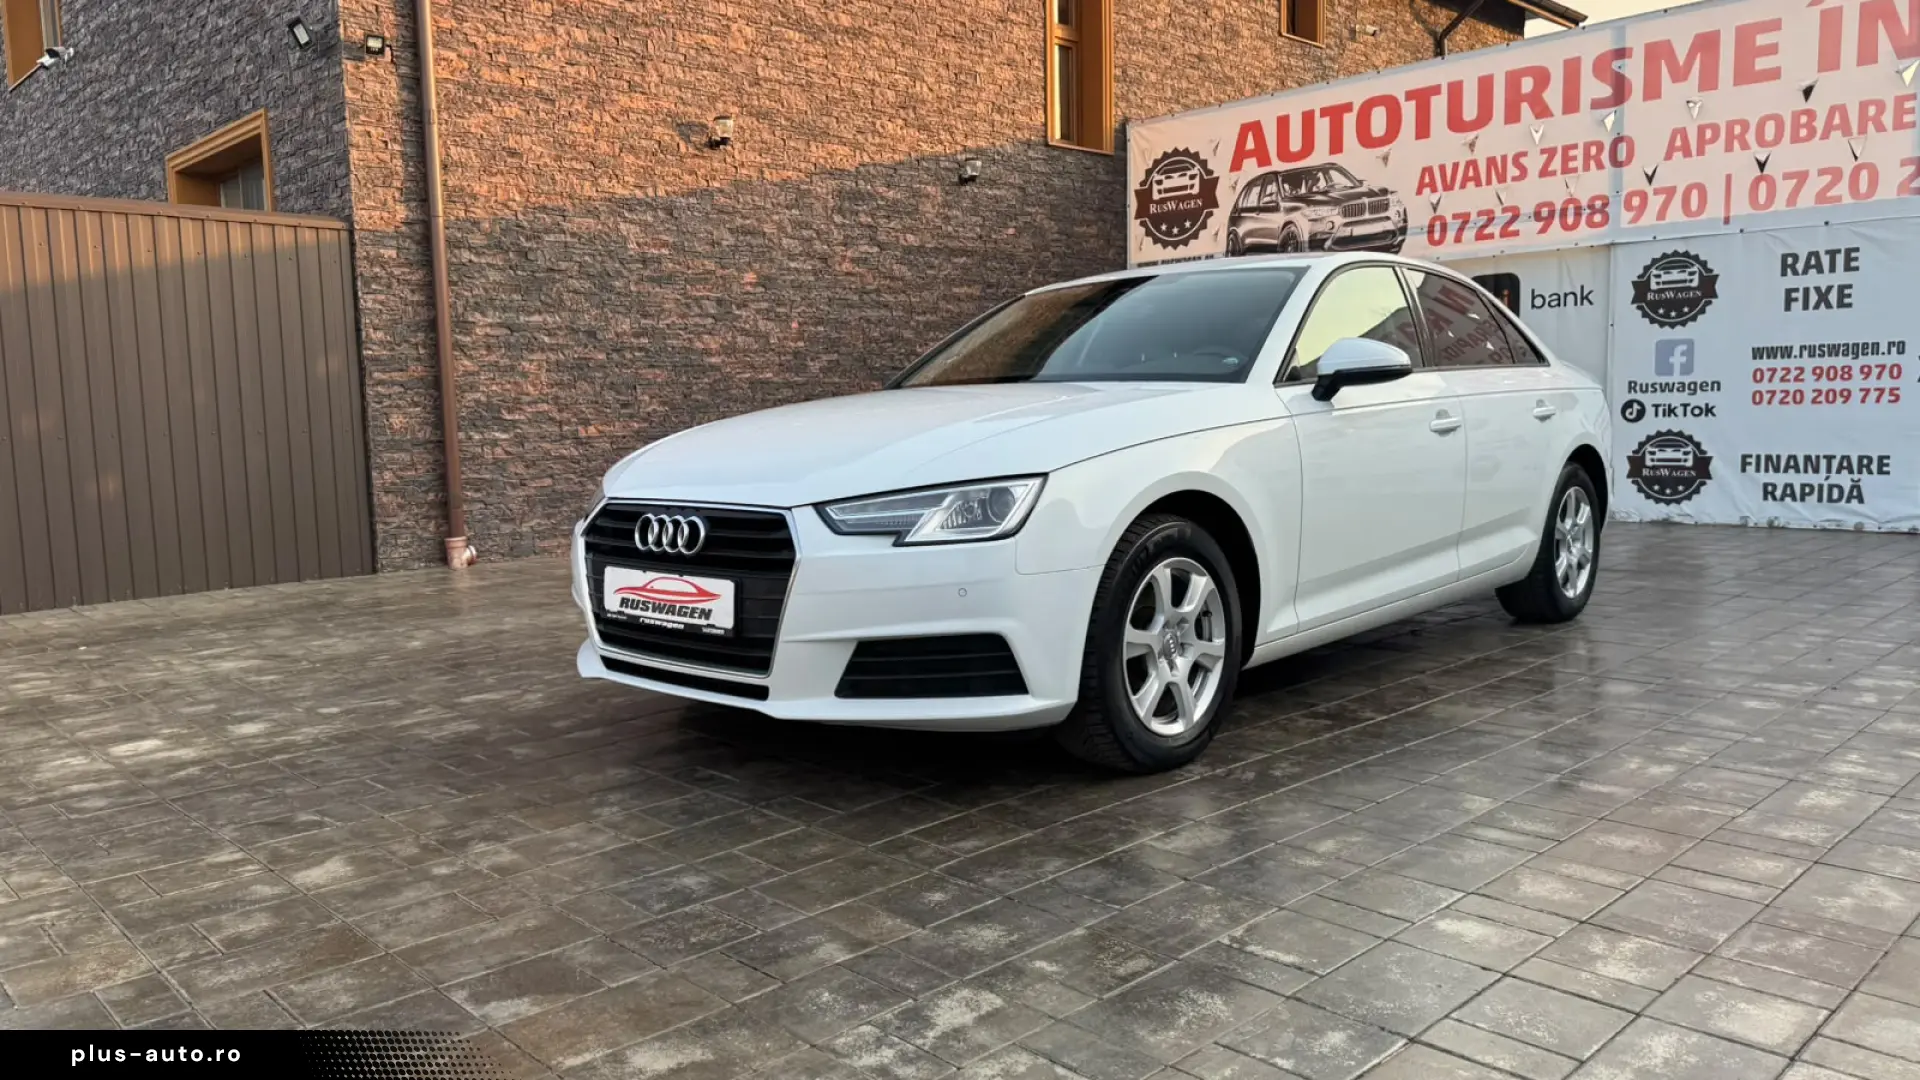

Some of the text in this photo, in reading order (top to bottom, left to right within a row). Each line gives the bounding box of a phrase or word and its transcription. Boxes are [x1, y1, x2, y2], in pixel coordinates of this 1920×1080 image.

[1229, 17, 1783, 173] AUTOTURISME
[1415, 92, 1918, 196] AVANS ZERO APROBARE
[1427, 205, 1521, 247] 0722
[1533, 194, 1610, 235] 908
[1624, 181, 1708, 225] 970
[1748, 161, 1880, 212] 0720
[1780, 247, 1861, 278] RATE
[1530, 284, 1595, 310] bank
[1783, 283, 1854, 312] FIXE
[1751, 340, 1906, 360] www.ruswagen.ro
[1752, 366, 1805, 384] 0722
[1811, 364, 1853, 382] 908
[1859, 363, 1902, 381] 970
[1627, 379, 1722, 396] Ruswagen
[1751, 386, 1901, 406] 0720 209 775
[1651, 402, 1717, 418] TikTok
[1762, 477, 1865, 504] RAPIDĂ
[618, 596, 713, 621] RUSWAGEN
